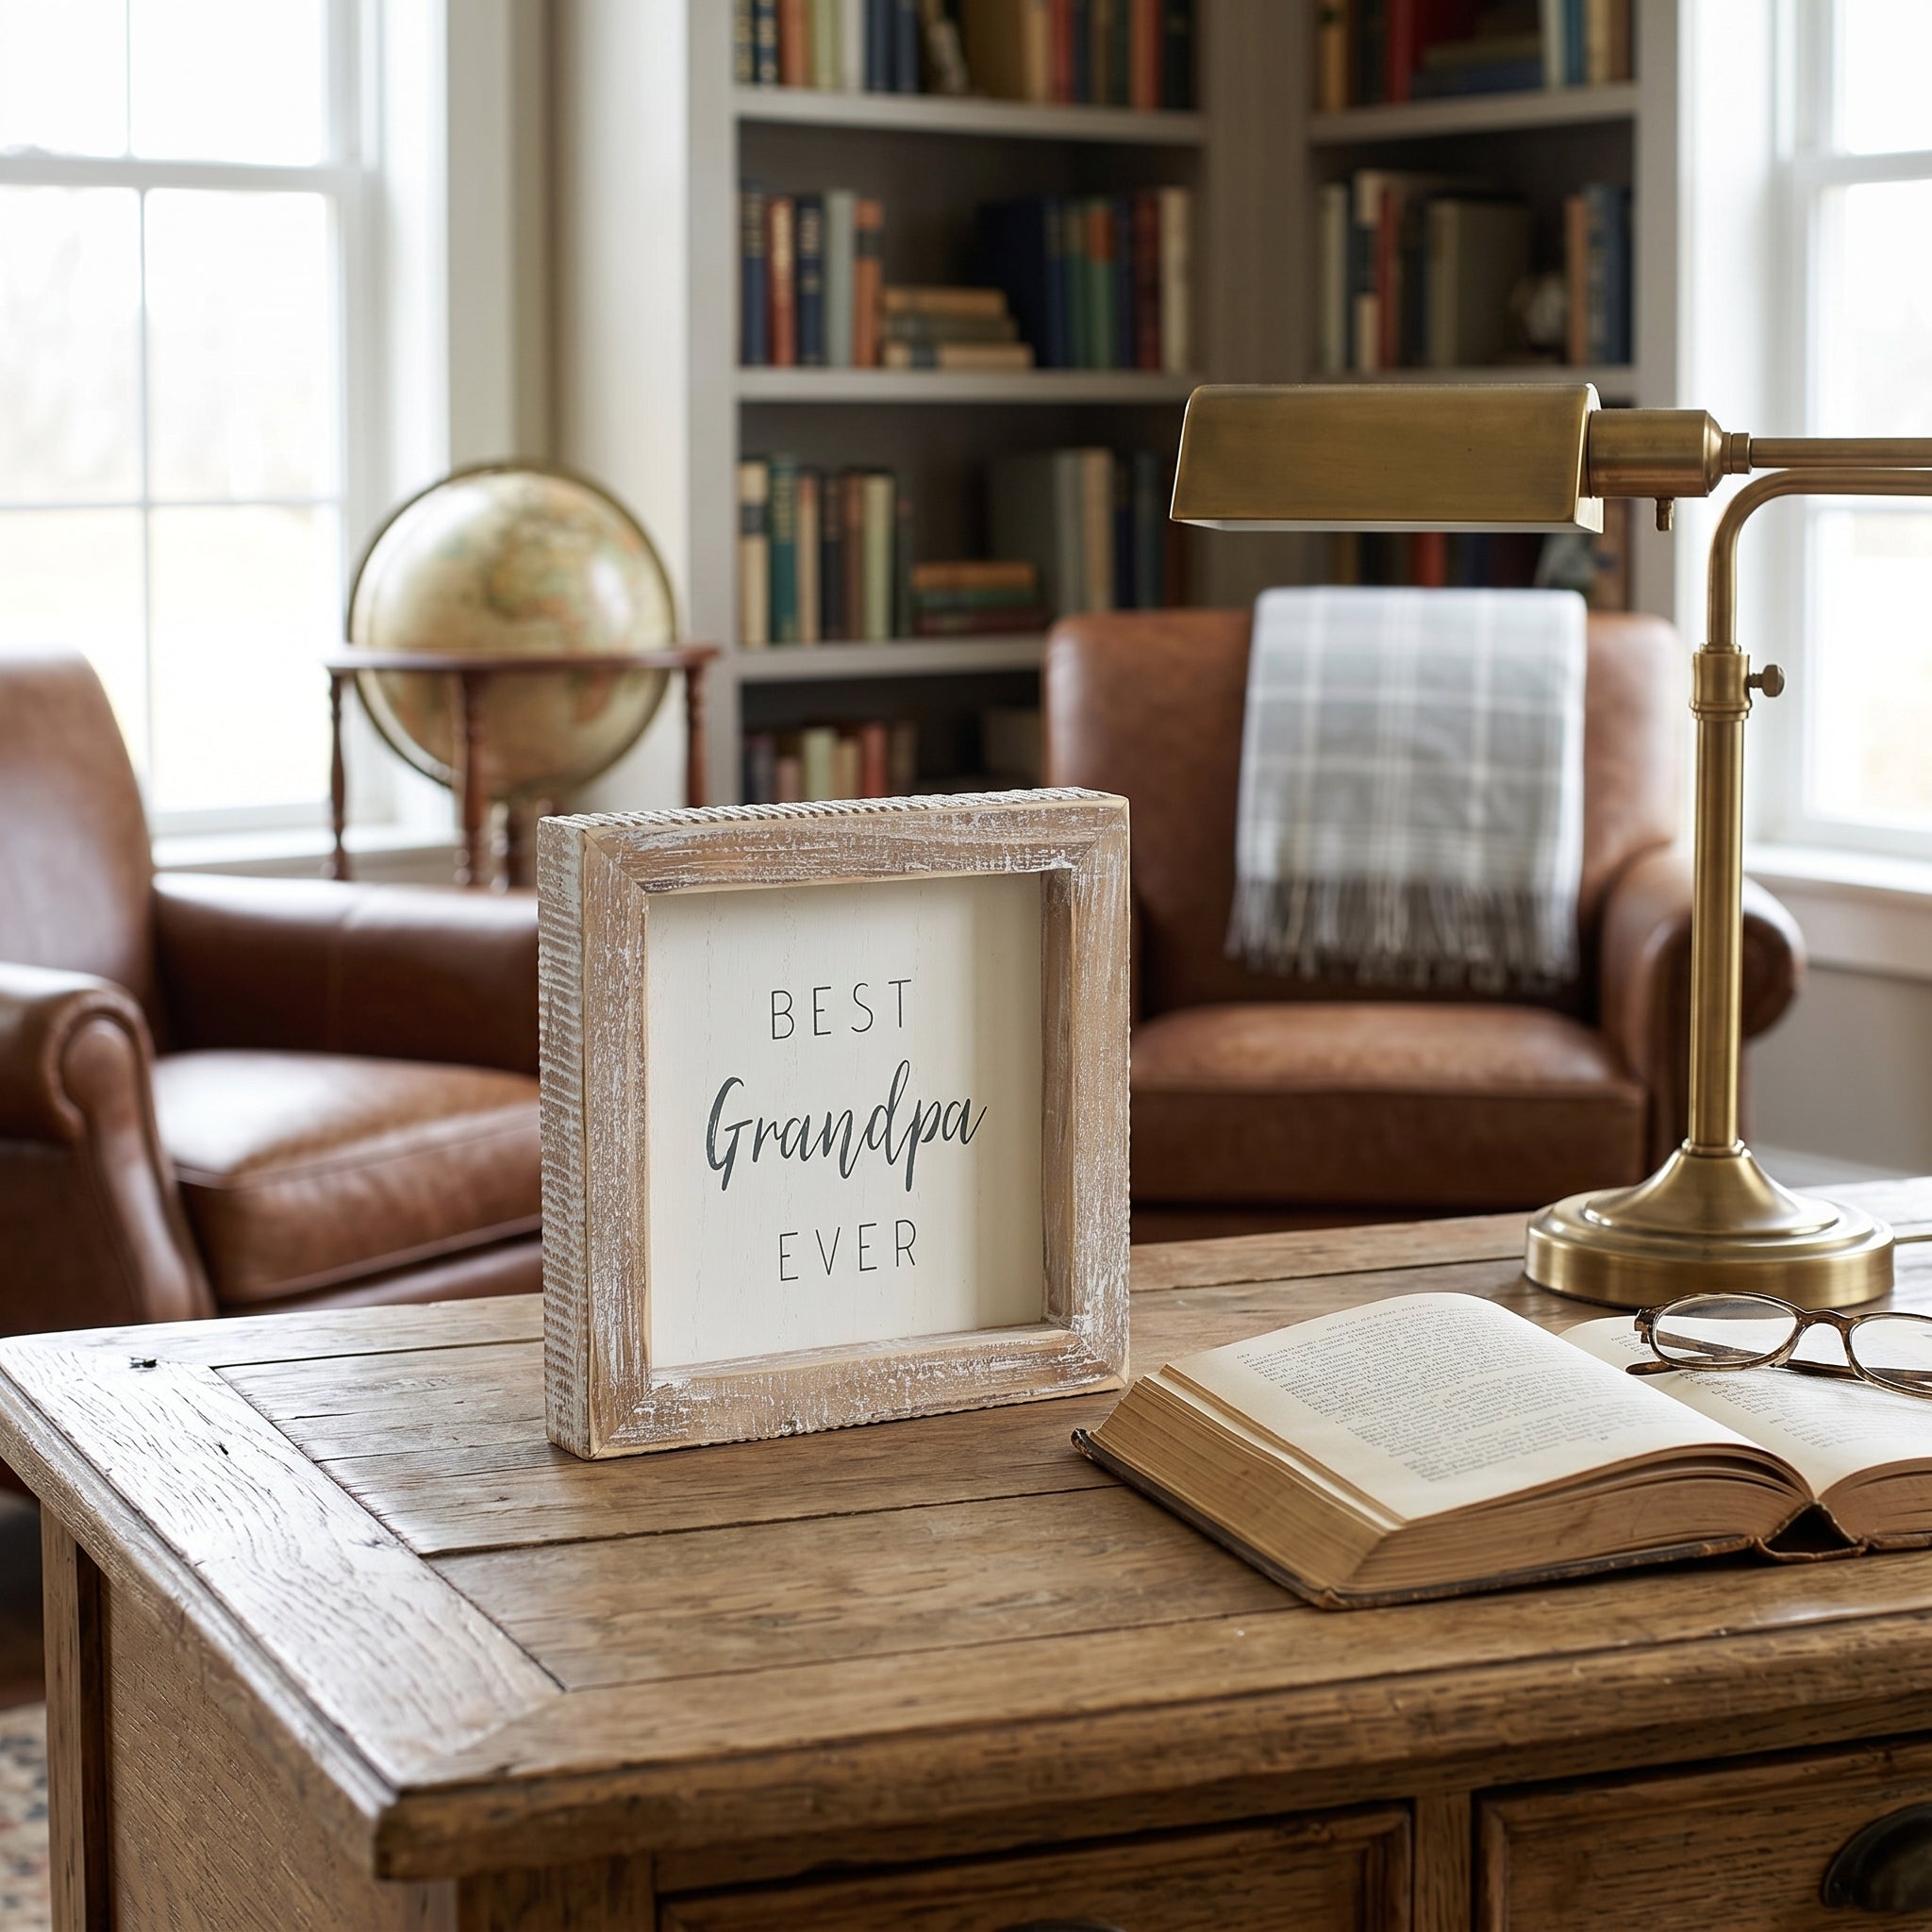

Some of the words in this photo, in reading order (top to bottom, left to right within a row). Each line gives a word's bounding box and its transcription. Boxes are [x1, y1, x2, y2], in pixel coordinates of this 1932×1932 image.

[771, 978, 912, 1041] BEST
[706, 1059, 988, 1192] Grandpa
[779, 1219, 917, 1282] EVER
